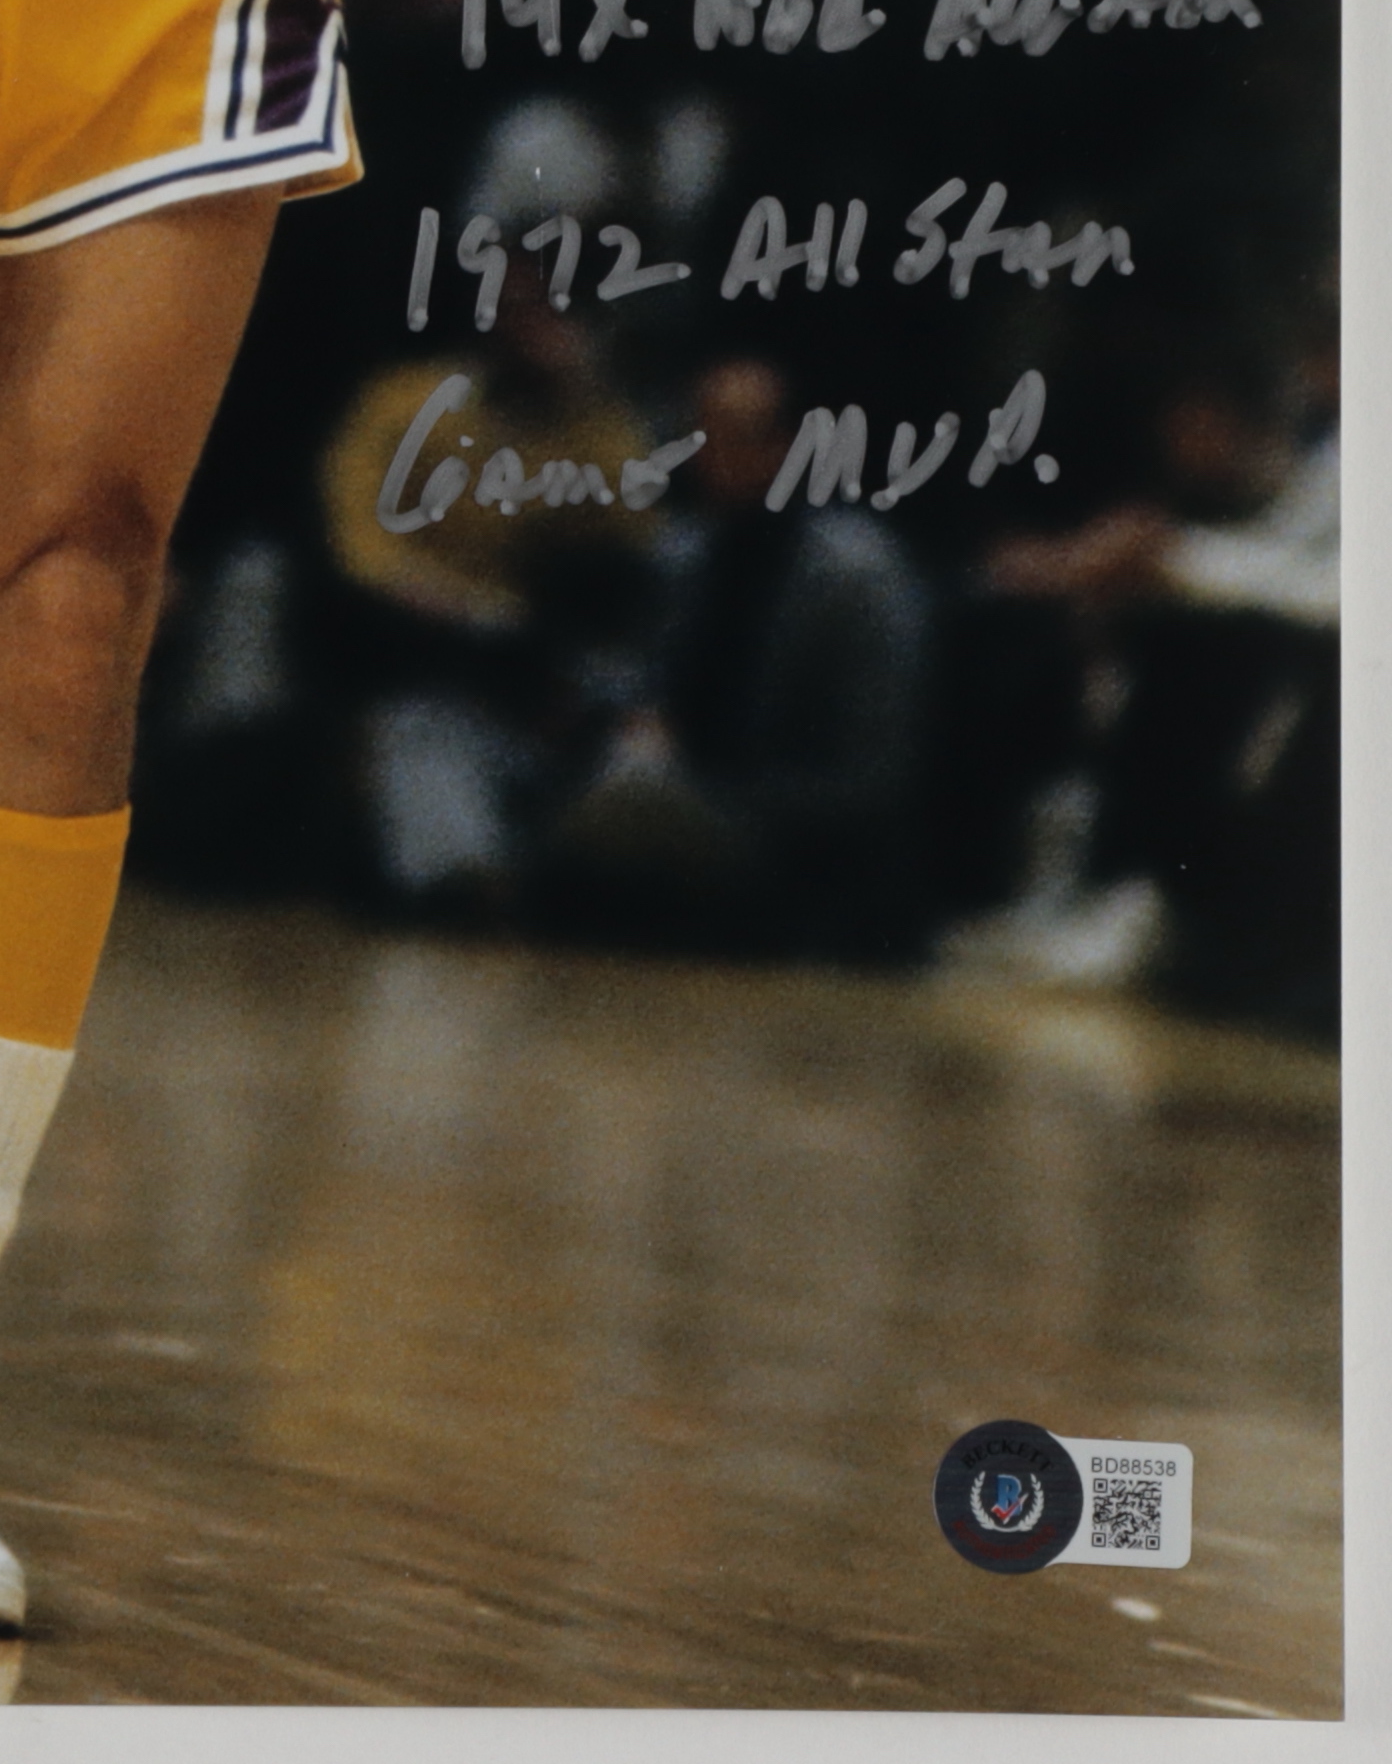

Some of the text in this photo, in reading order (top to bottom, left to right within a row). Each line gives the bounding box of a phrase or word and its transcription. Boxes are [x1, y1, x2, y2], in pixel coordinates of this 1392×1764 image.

[407, 206, 692, 332] 1972
[720, 195, 869, 301] All
[1090, 1456, 1178, 1478] BD88538
